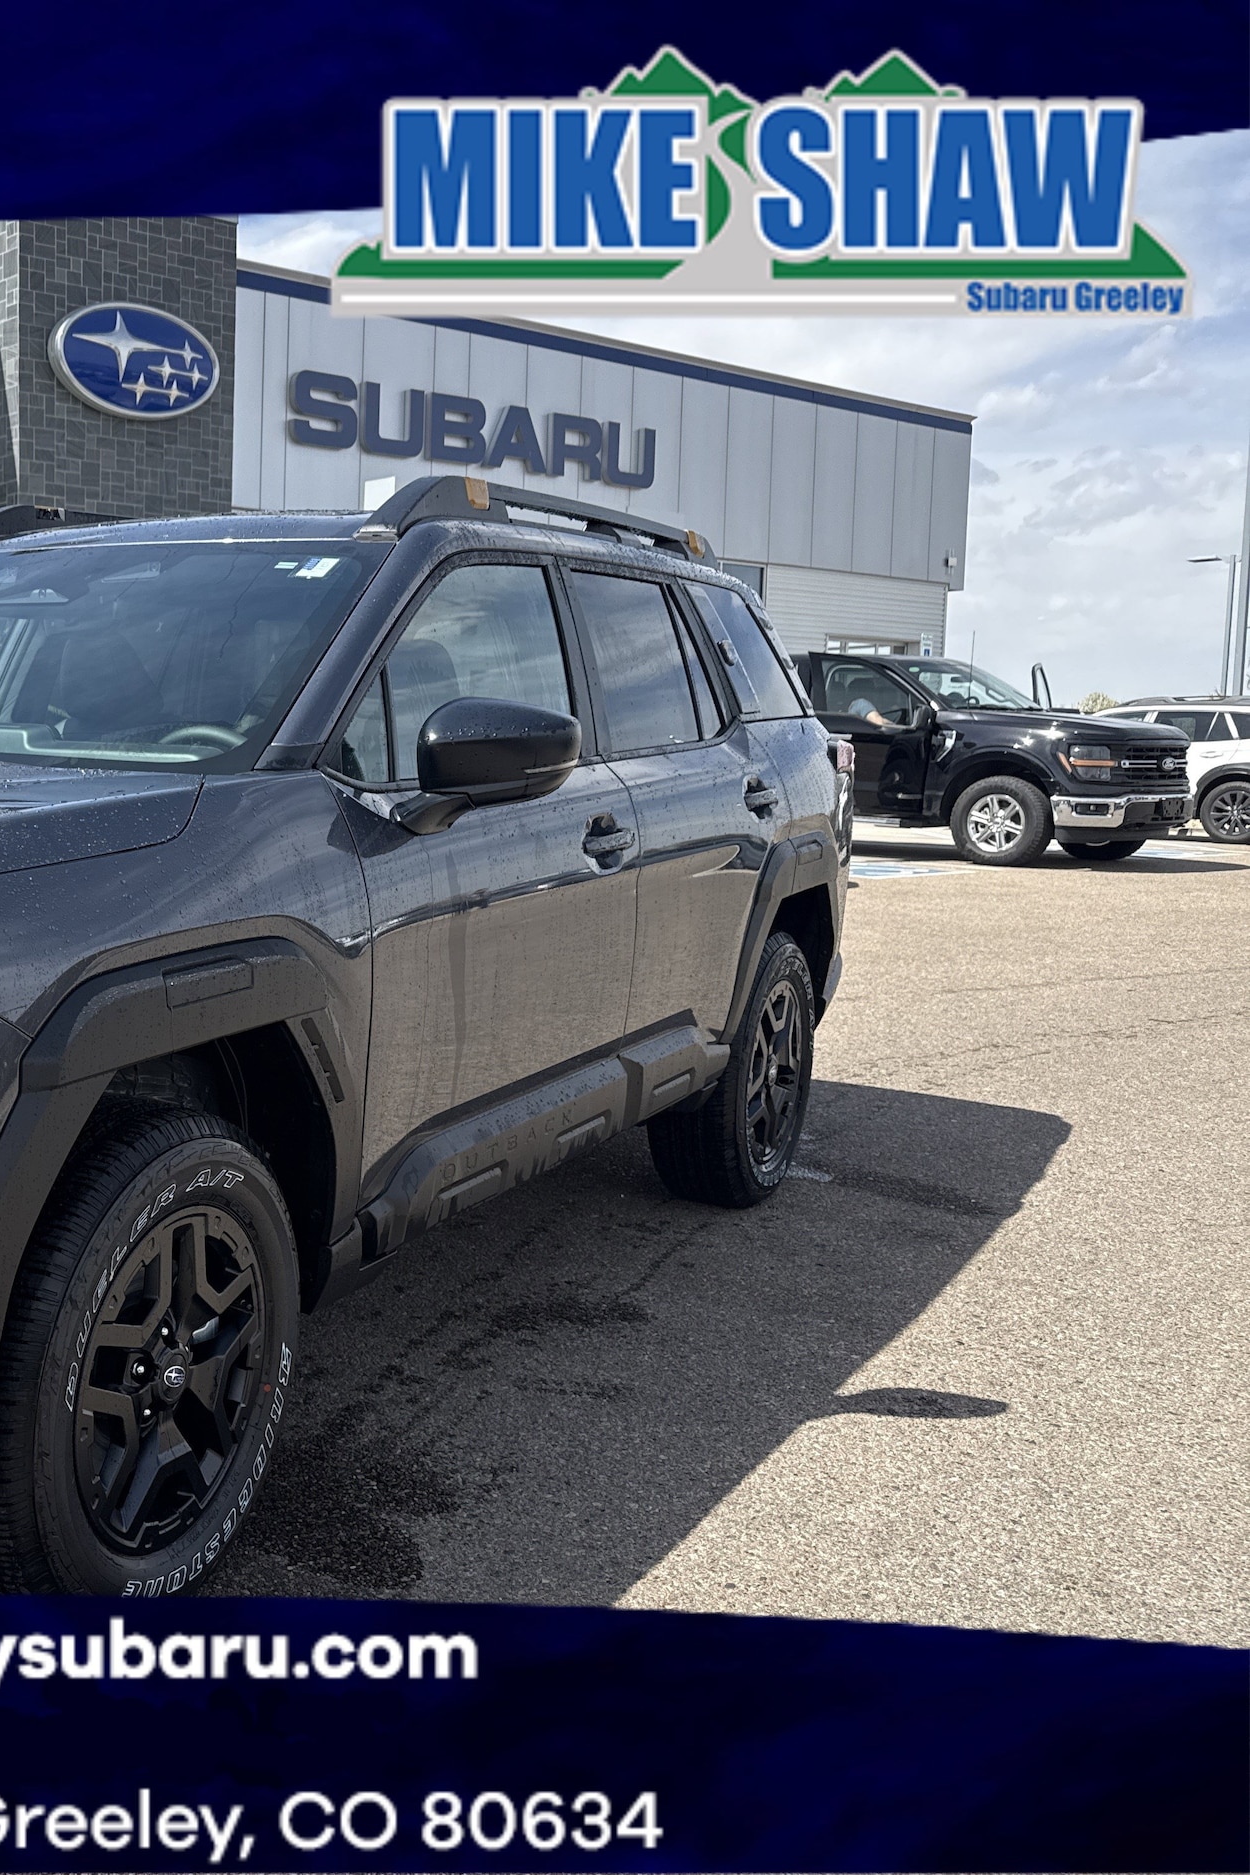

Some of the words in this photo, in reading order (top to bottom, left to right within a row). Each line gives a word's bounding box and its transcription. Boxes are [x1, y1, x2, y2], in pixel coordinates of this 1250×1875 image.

[288, 369, 656, 490] SUBARU
[442, 1109, 573, 1183] OUTBACK
[65, 1183, 177, 1412] DUELER
[186, 1168, 245, 1192] A/T
[121, 1341, 293, 1598] BRIDGESTONE
